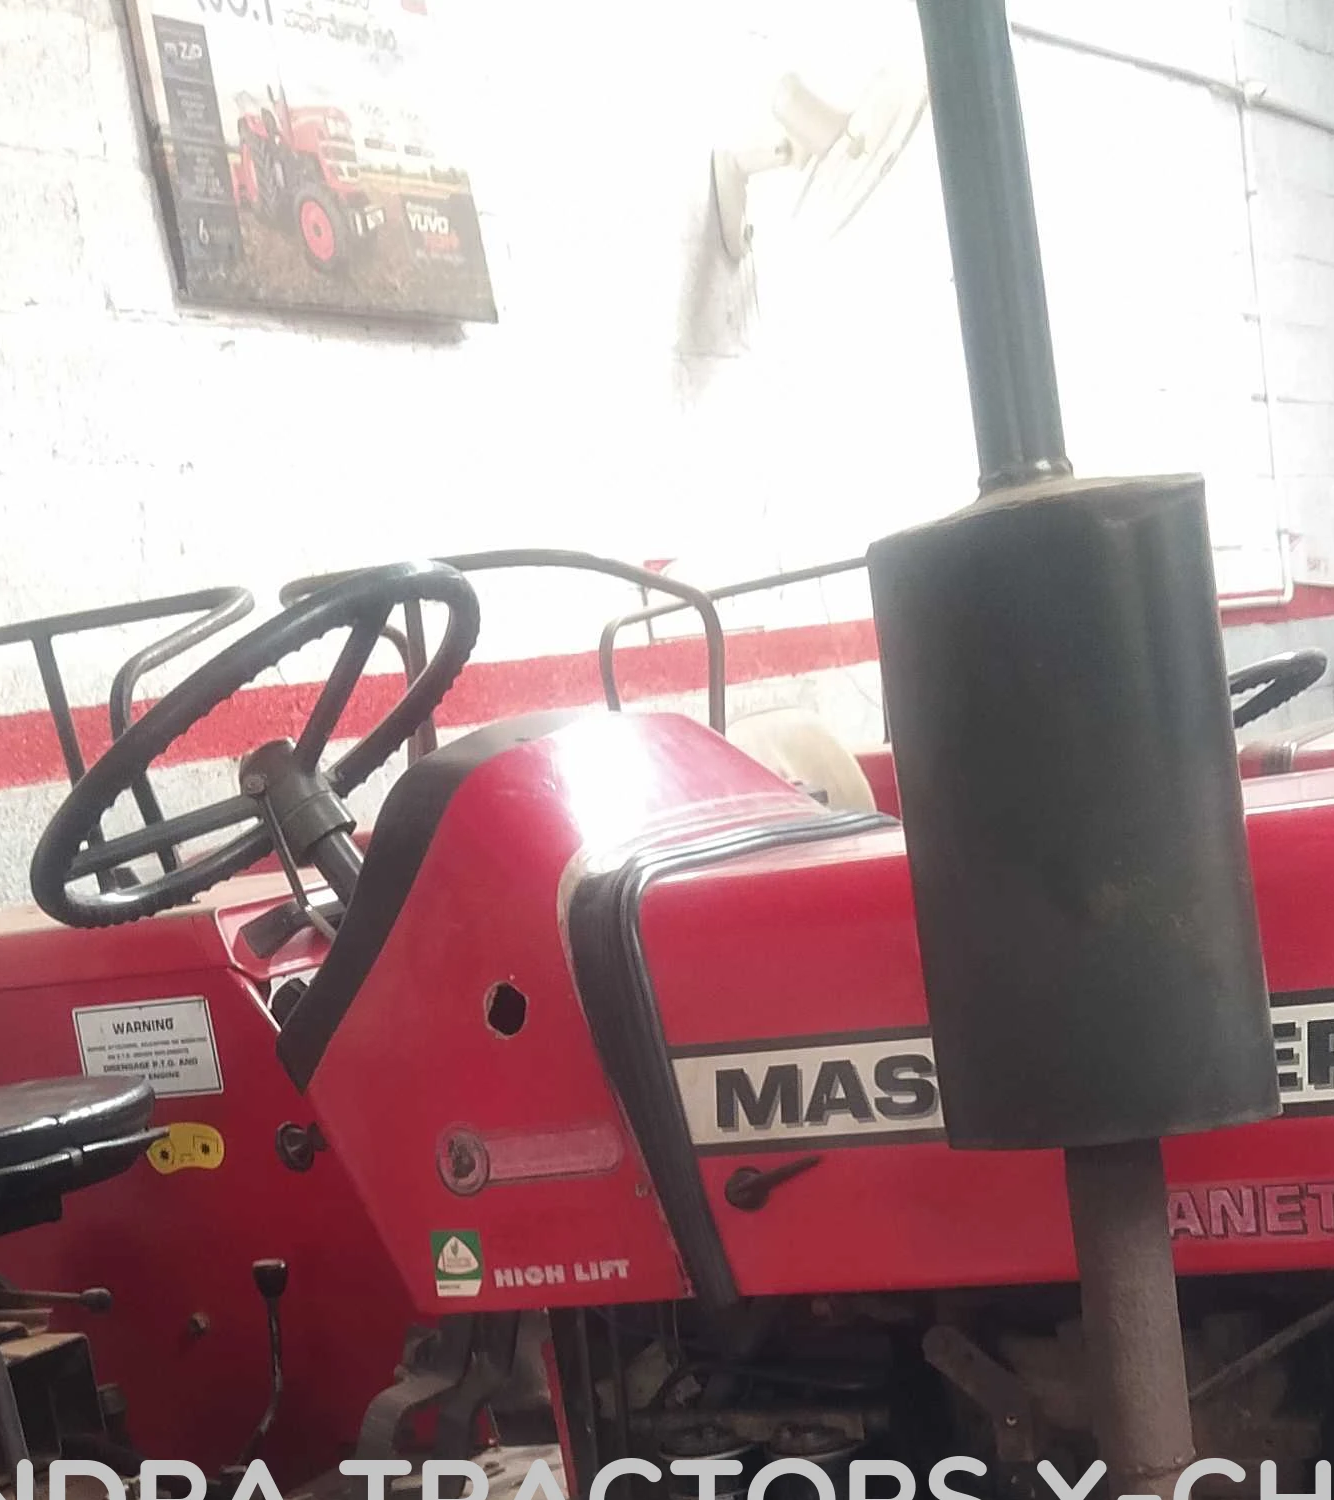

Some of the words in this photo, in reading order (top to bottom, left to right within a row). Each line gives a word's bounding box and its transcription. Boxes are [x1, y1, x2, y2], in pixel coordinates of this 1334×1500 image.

[112, 1017, 174, 1035] WARNING
[715, 1053, 940, 1133] MAS
[493, 1263, 568, 1289] HIGH
[574, 1258, 630, 1281] LIFT
